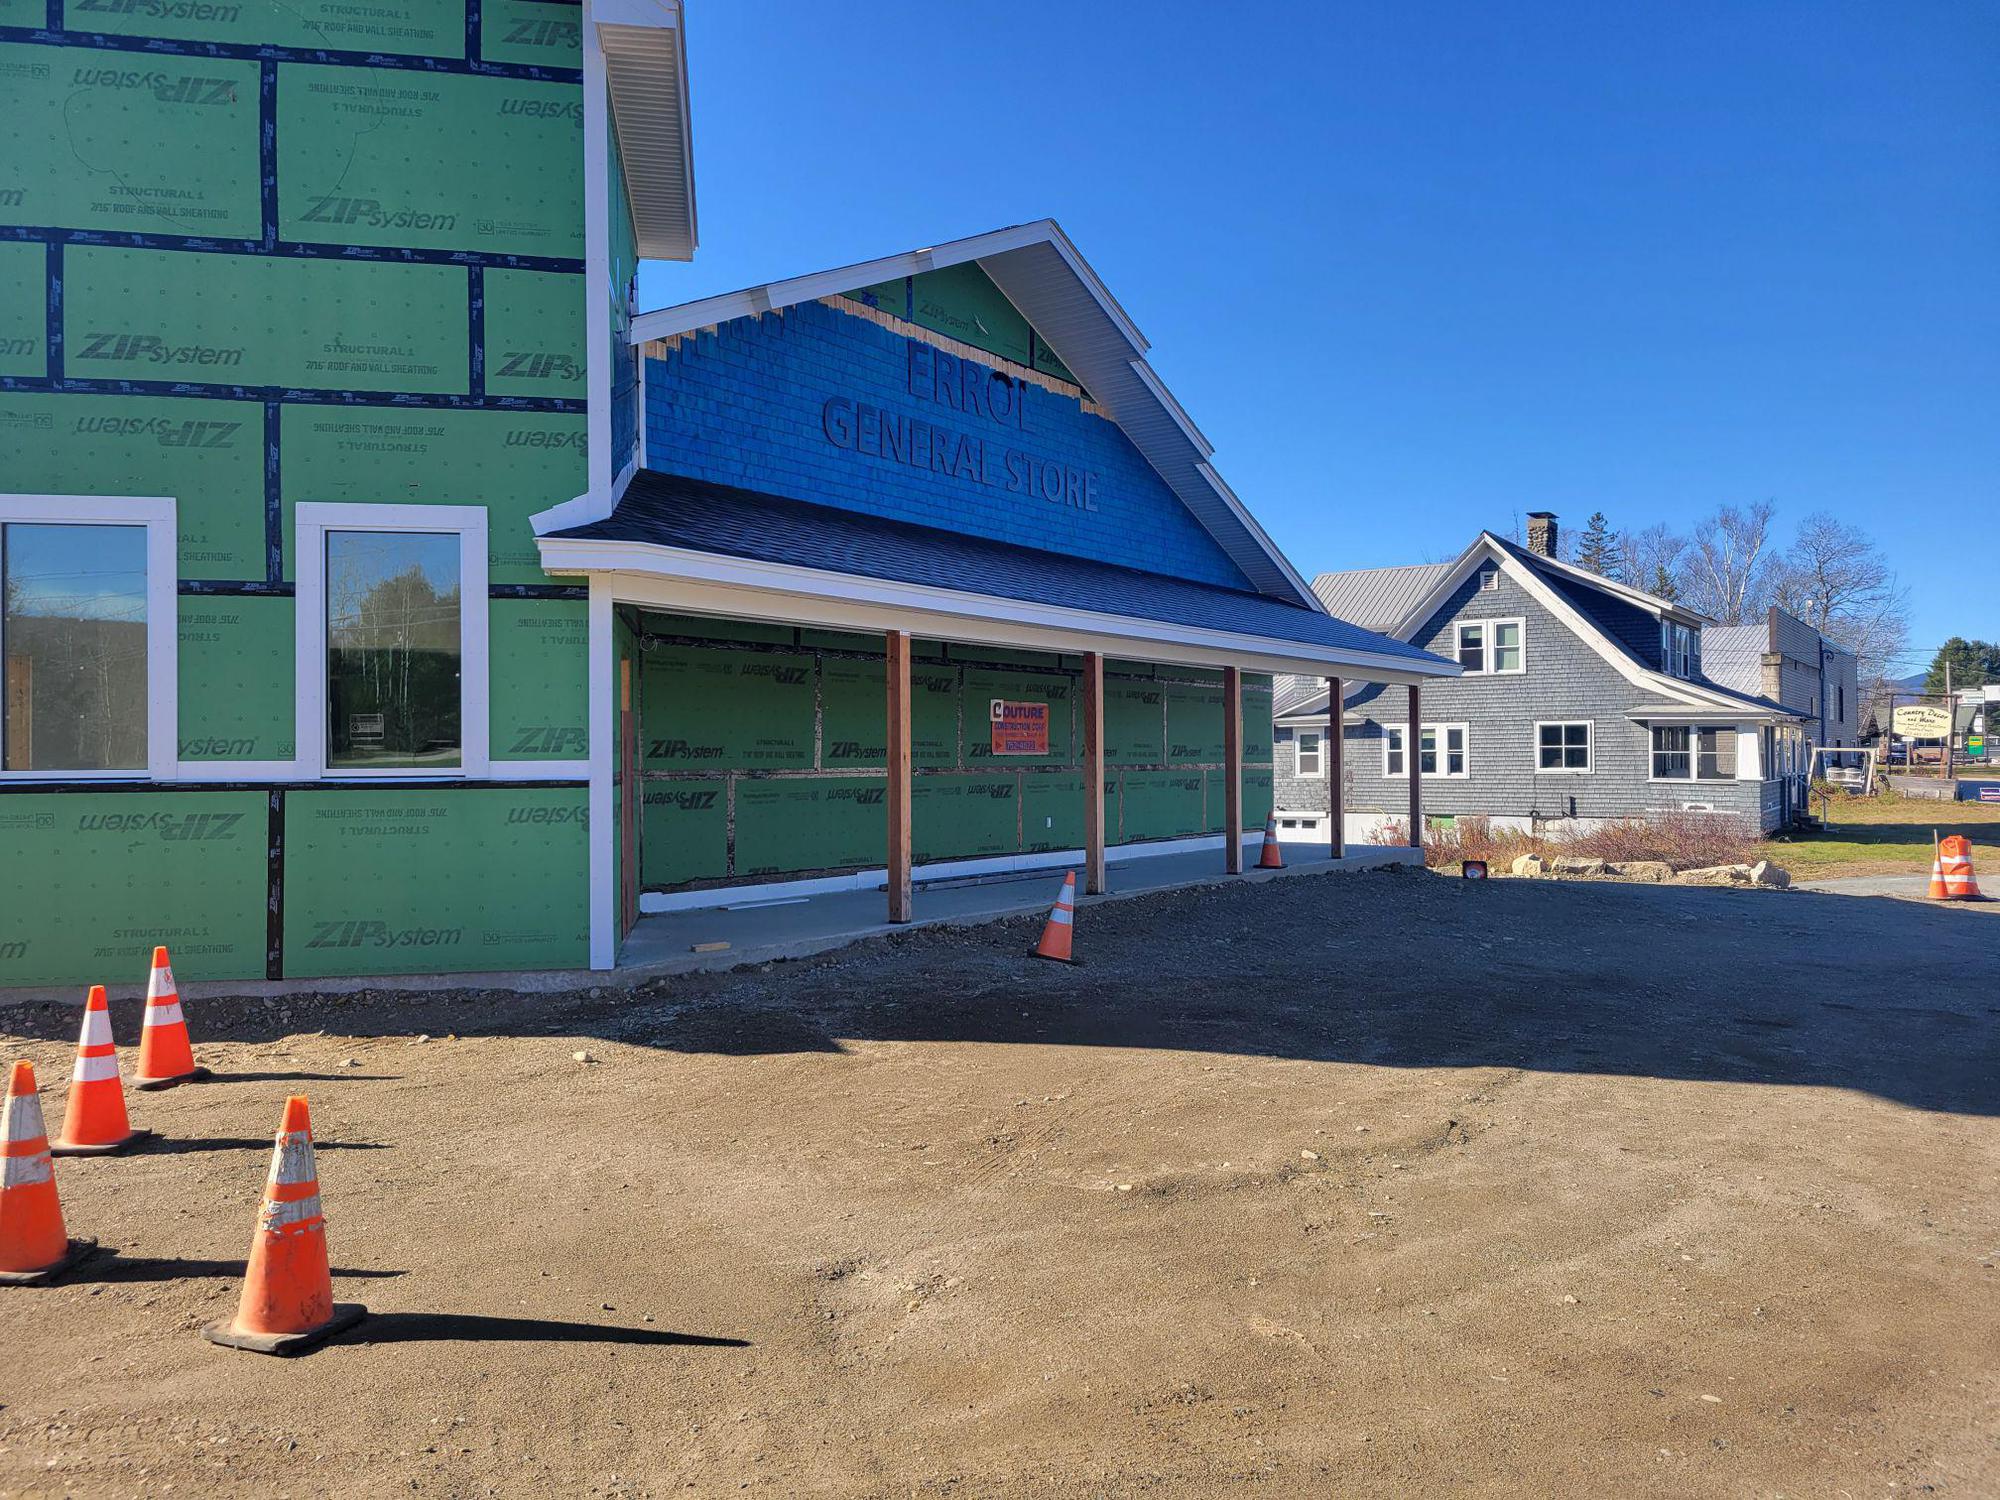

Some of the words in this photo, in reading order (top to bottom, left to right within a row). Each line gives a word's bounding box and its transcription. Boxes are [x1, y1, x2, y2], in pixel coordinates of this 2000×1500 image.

[320, 4, 400, 19] STRUCTURAL
[325, 21, 346, 33] ROOF
[347, 22, 364, 34] AND
[387, 25, 434, 39] SHEATHING
[308, 83, 356, 96] SHEATHING
[397, 88, 417, 100] ROOF
[346, 103, 424, 118] STRUCTURAL
[501, 98, 583, 128] system
[110, 185, 193, 199] STRUCTURAL
[113, 203, 136, 214] ROOF
[324, 344, 406, 357] STRUCTURAL
[327, 361, 350, 372] ROOF
[351, 362, 367, 373] AND
[390, 364, 438, 376] SHEATHING
[907, 339, 1028, 432] ERROL
[313, 422, 361, 433] SHEATHING
[401, 425, 423, 436] ROOF
[350, 441, 428, 454] STRUCTURAL
[505, 430, 588, 459] system
[822, 396, 995, 488] GENERAL
[1004, 447, 1100, 513] STORE
[993, 702, 1044, 719] COUTURE
[178, 736, 256, 757] ystem
[508, 727, 587, 753] ZIPs
[647, 739, 724, 760] ZIPsystem
[508, 806, 590, 832] system
[349, 825, 430, 835] STRUCTURAL
[113, 927, 199, 938] STRUCTURAL
